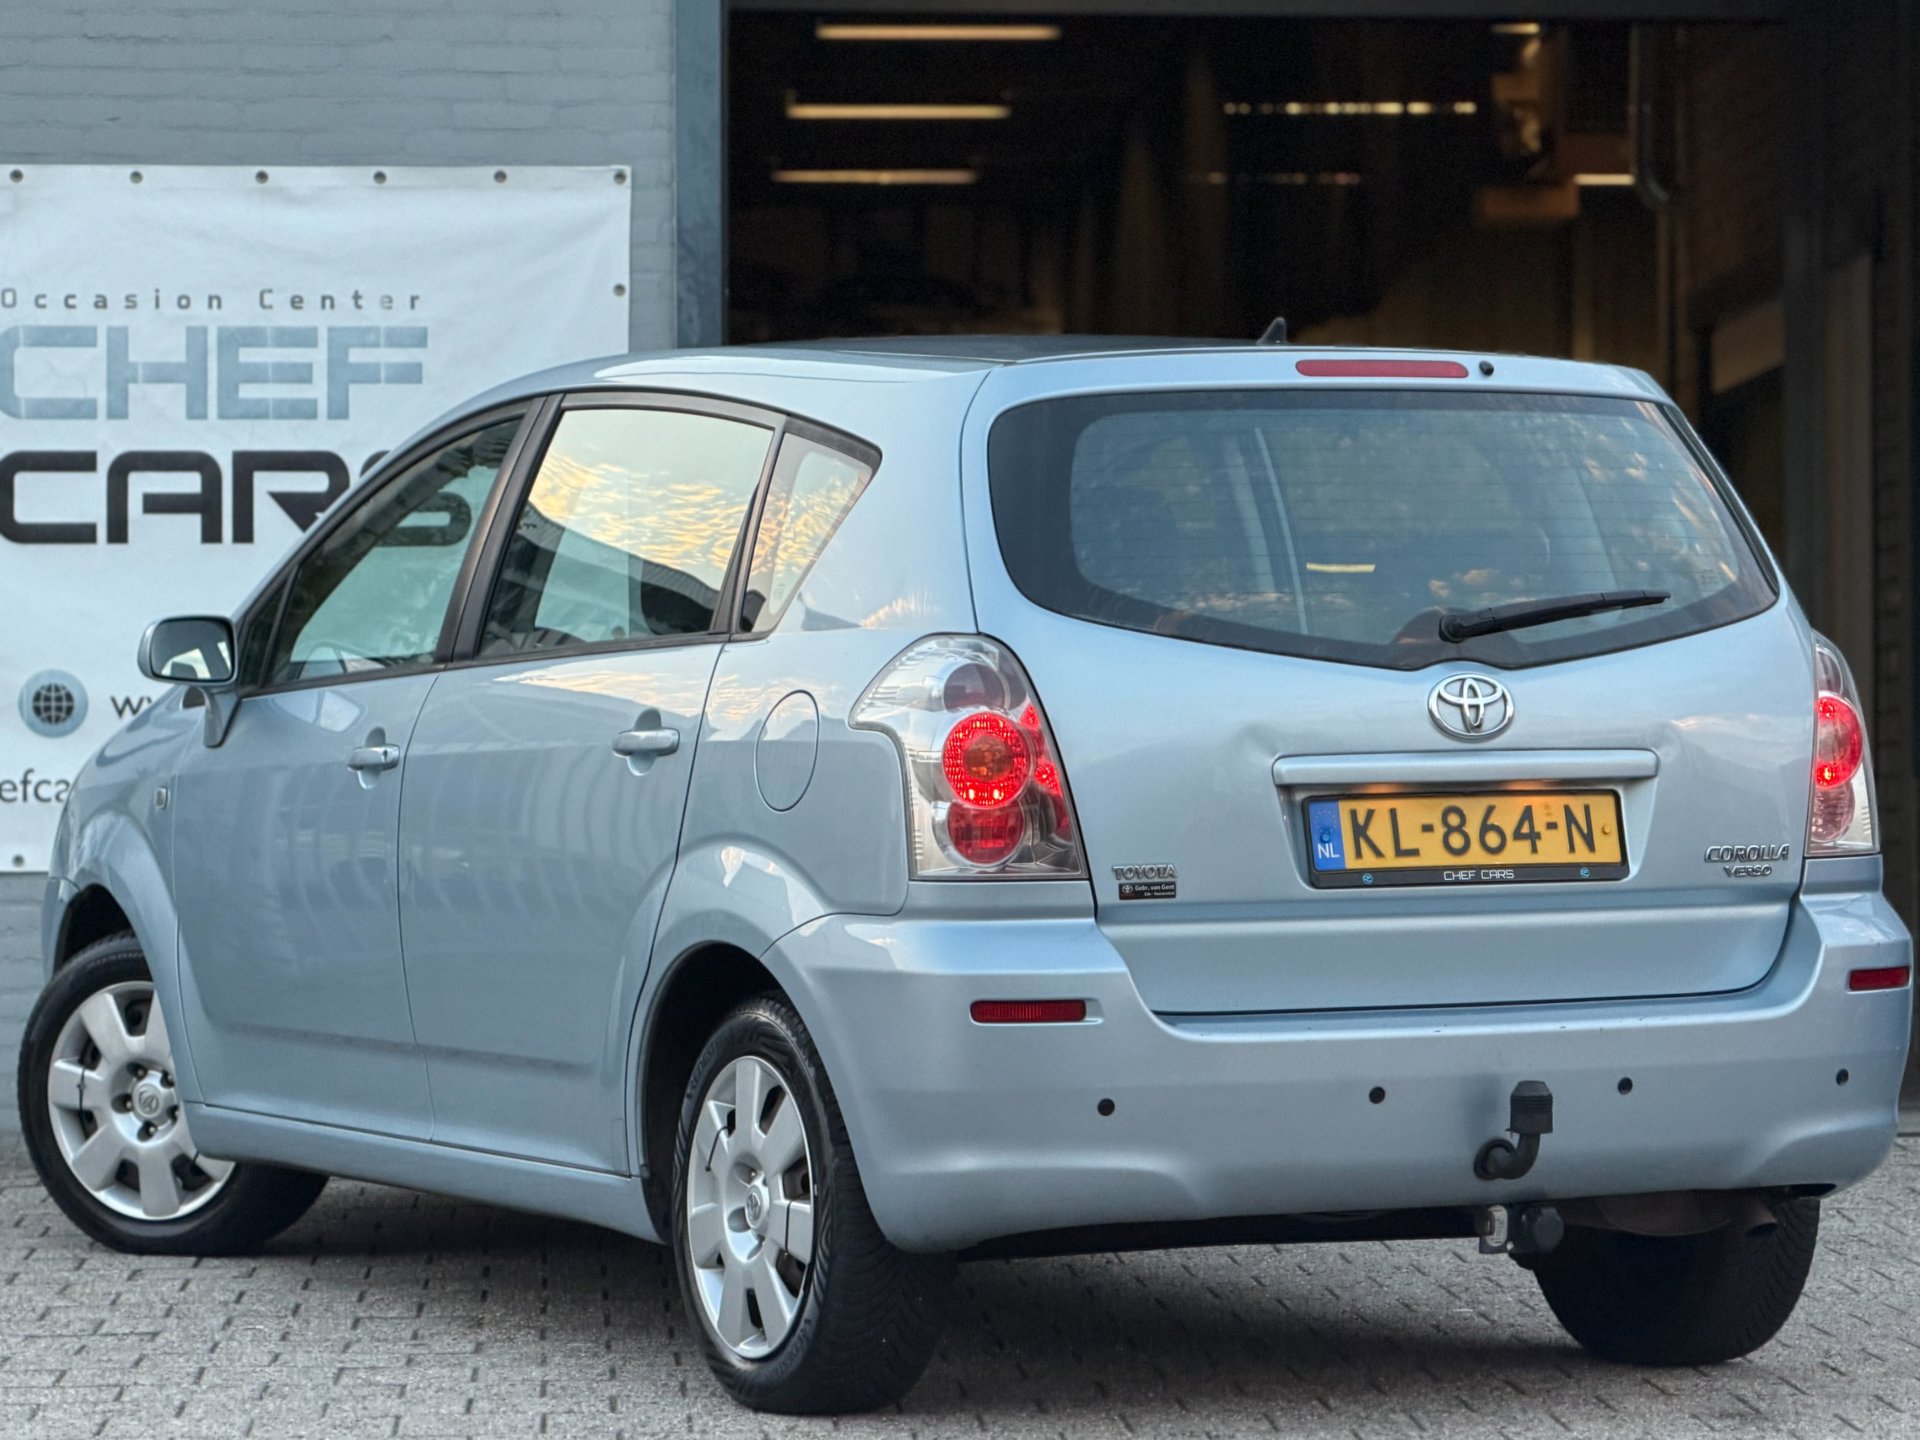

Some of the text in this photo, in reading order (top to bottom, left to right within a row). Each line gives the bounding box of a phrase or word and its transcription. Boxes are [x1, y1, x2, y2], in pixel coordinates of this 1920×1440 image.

[1, 288, 421, 310] Occasion Center
[0, 325, 429, 420] CHEF
[1349, 803, 1597, 861] KL-864-N
[1317, 842, 1340, 858] NL
[1705, 843, 1790, 862] COROLLA
[1112, 864, 1176, 880] TOYOTA
[1443, 869, 1515, 881] CHEF CARS
[1724, 864, 1773, 877] VERSO
